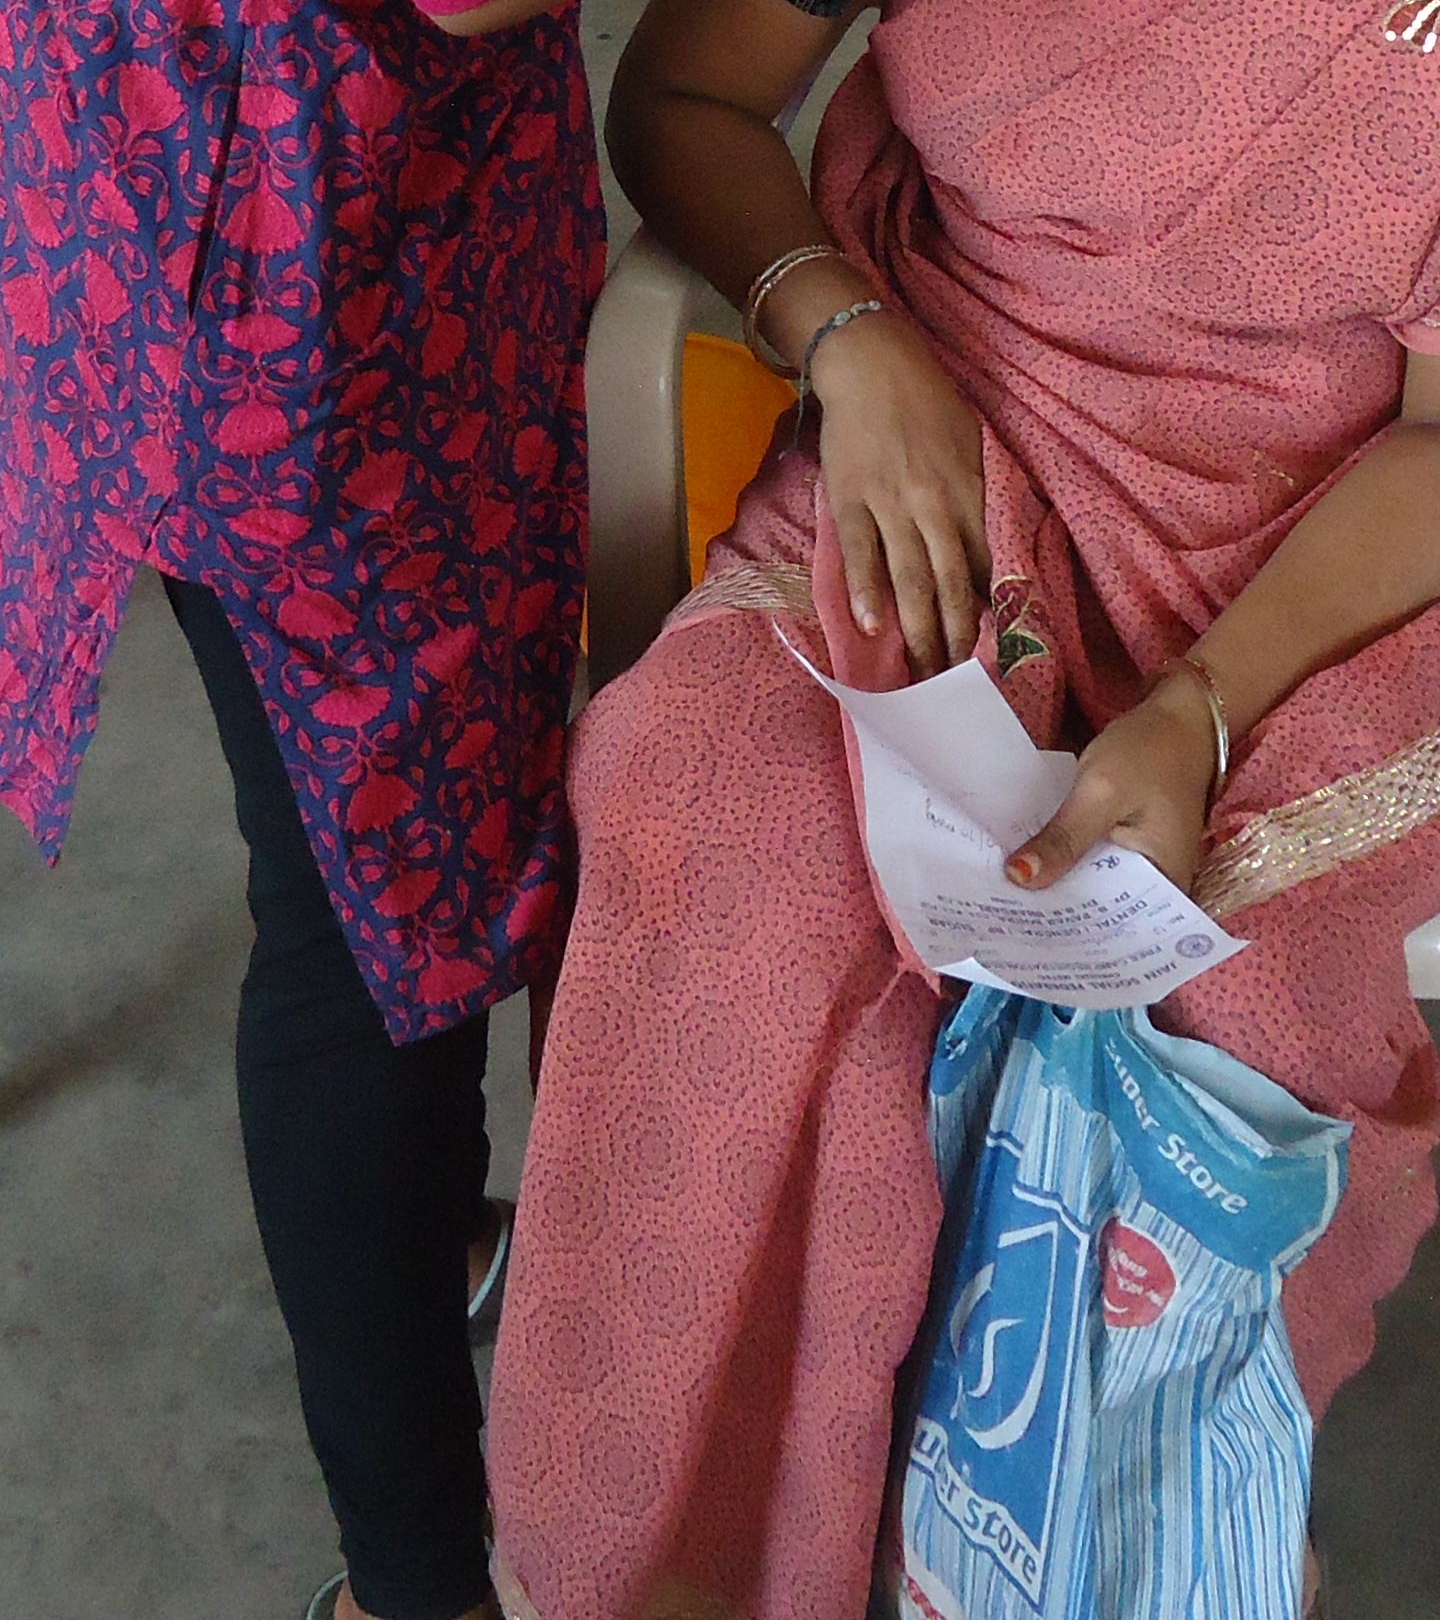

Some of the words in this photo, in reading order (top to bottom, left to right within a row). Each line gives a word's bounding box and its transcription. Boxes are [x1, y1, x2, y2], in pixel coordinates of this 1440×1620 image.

[1095, 901, 1148, 929] DENTAL
[1143, 963, 1177, 980] JAIN
[1088, 977, 1140, 990] SOCIAL
[1159, 1133, 1248, 1215] Store
